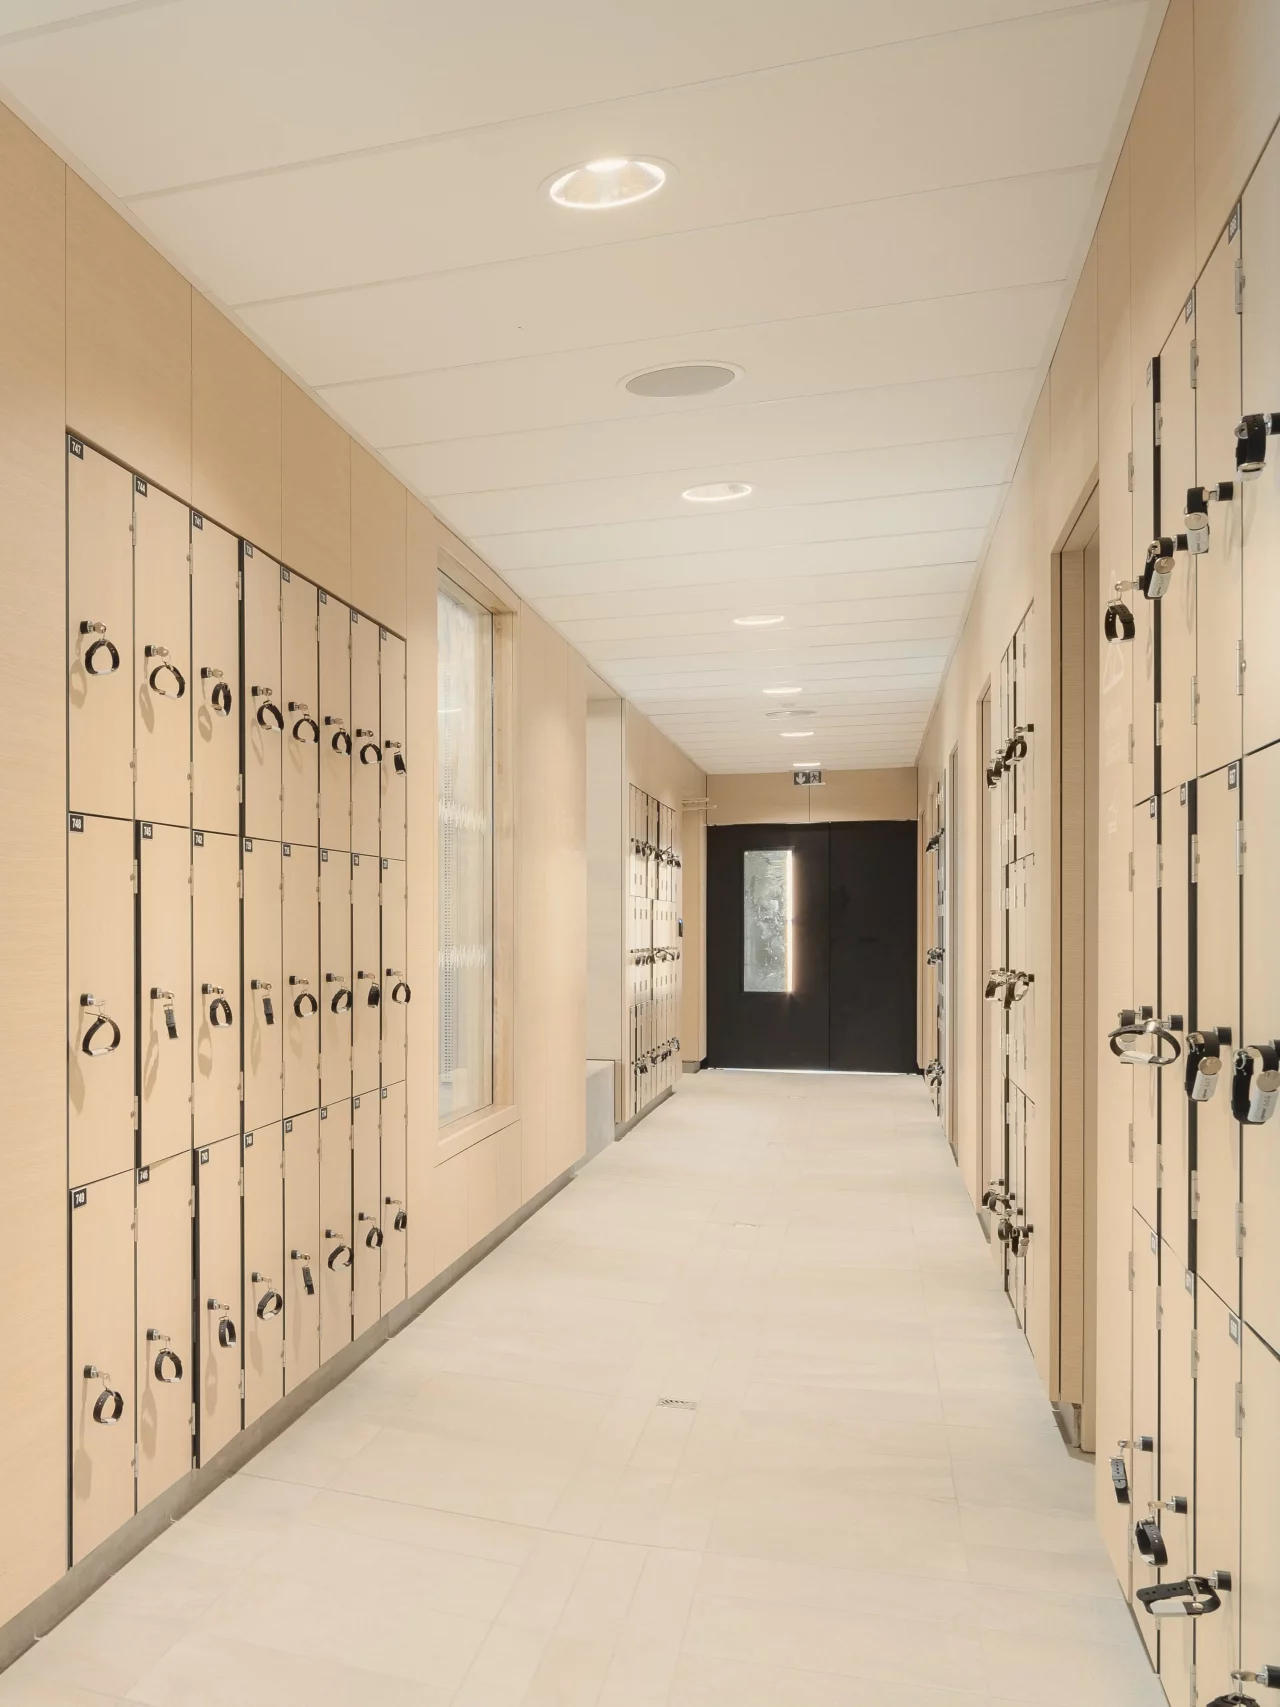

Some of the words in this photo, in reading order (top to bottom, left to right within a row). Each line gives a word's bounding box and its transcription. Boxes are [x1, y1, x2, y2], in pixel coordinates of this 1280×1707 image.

[72, 441, 81, 455] 747
[137, 480, 145, 493] 744
[194, 516, 202, 527] 741
[72, 818, 81, 829] 748
[140, 1169, 148, 1181] 746
[75, 1192, 84, 1205] 749
